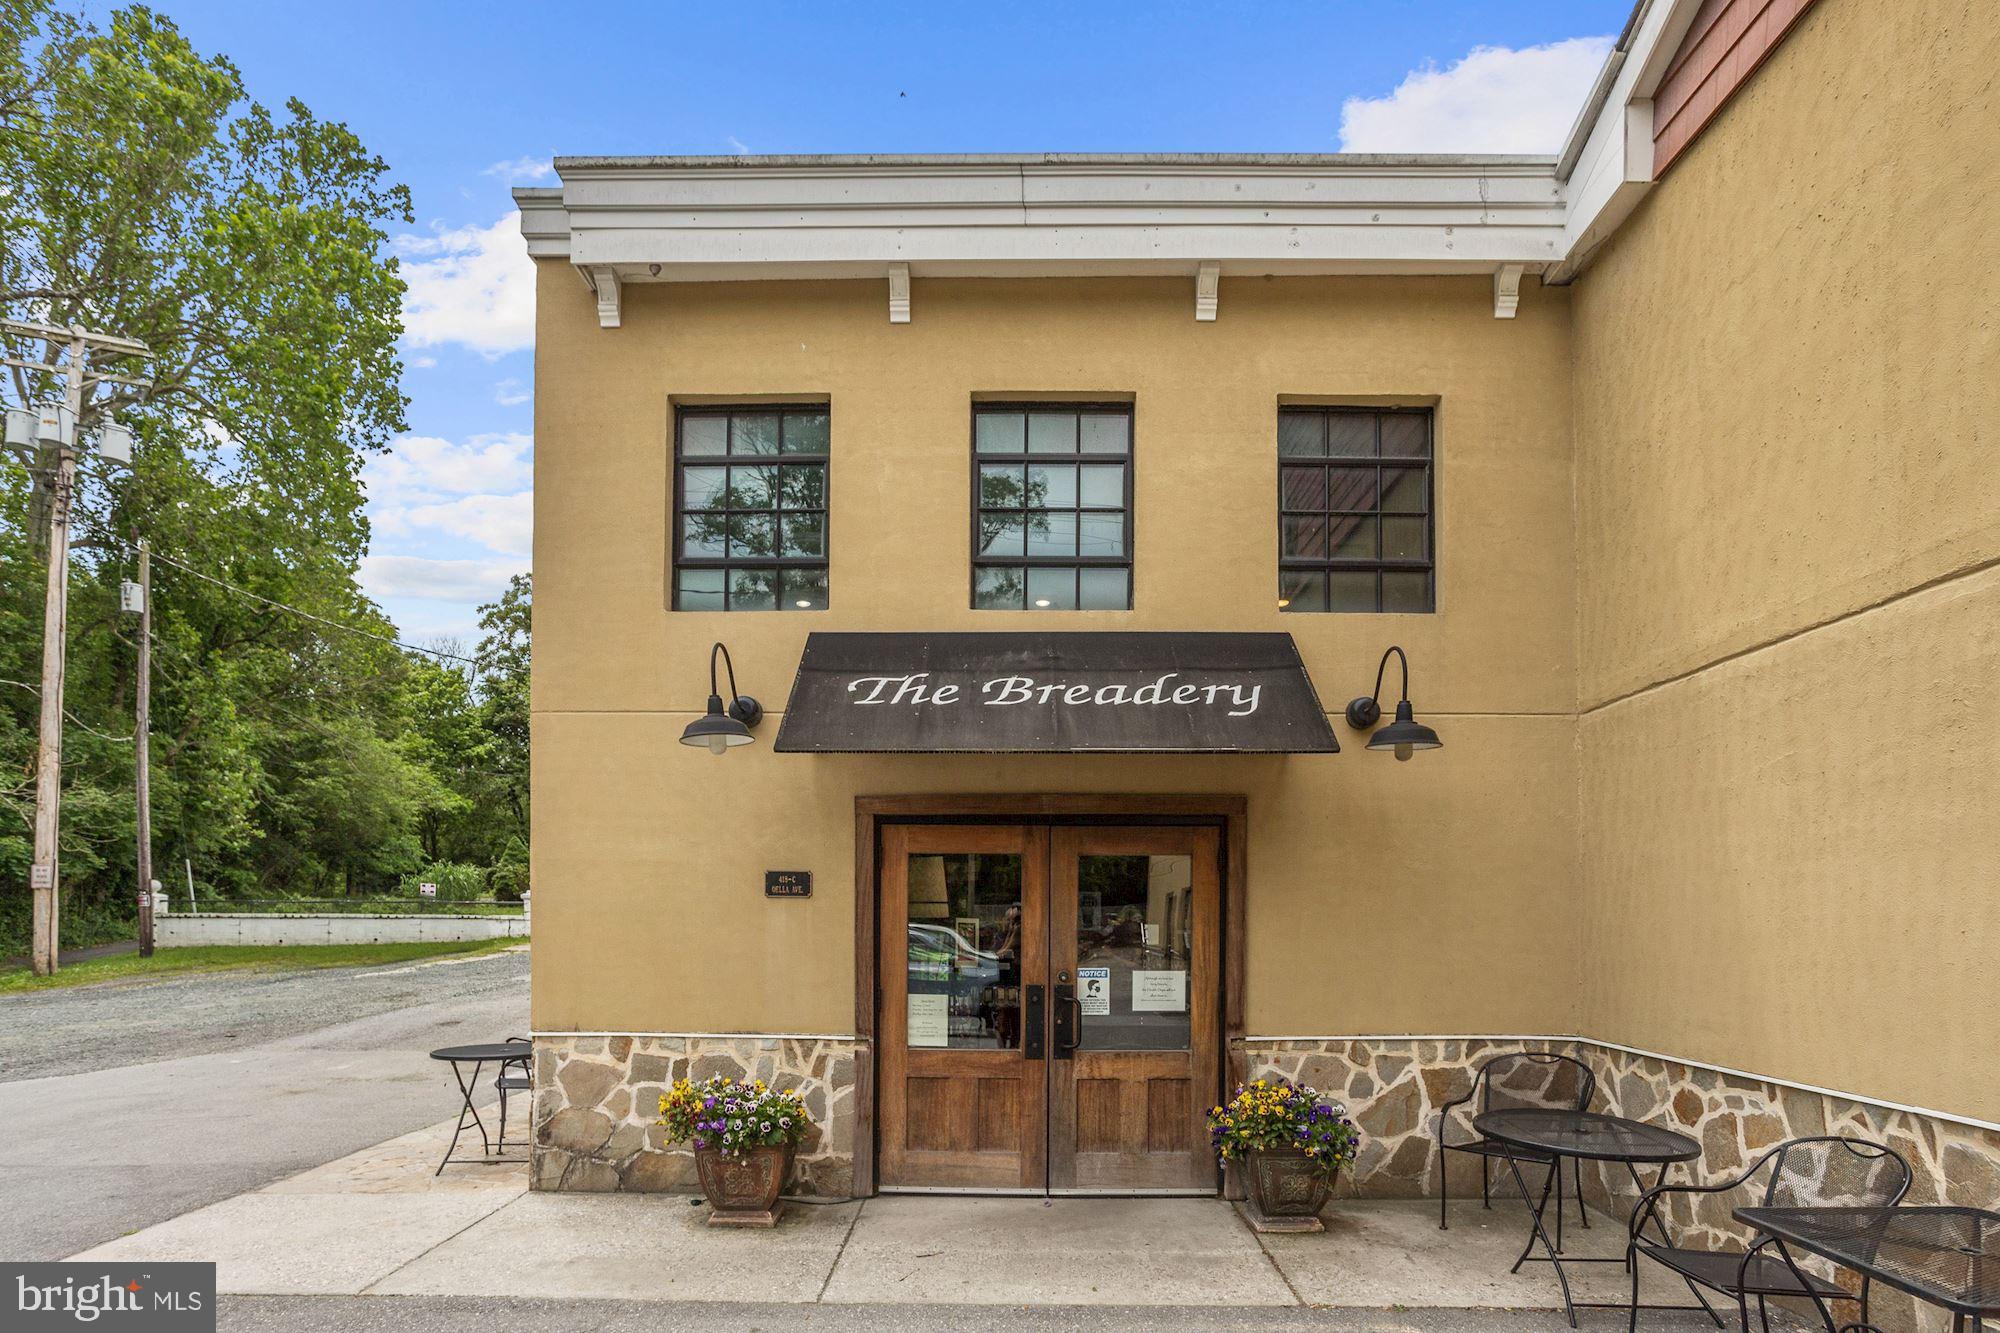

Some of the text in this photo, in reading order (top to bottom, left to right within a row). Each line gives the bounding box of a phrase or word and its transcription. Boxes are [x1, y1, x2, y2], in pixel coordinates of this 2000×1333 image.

[847, 673, 1262, 717] The Breadery
[1078, 969, 1107, 978] NOTICE
